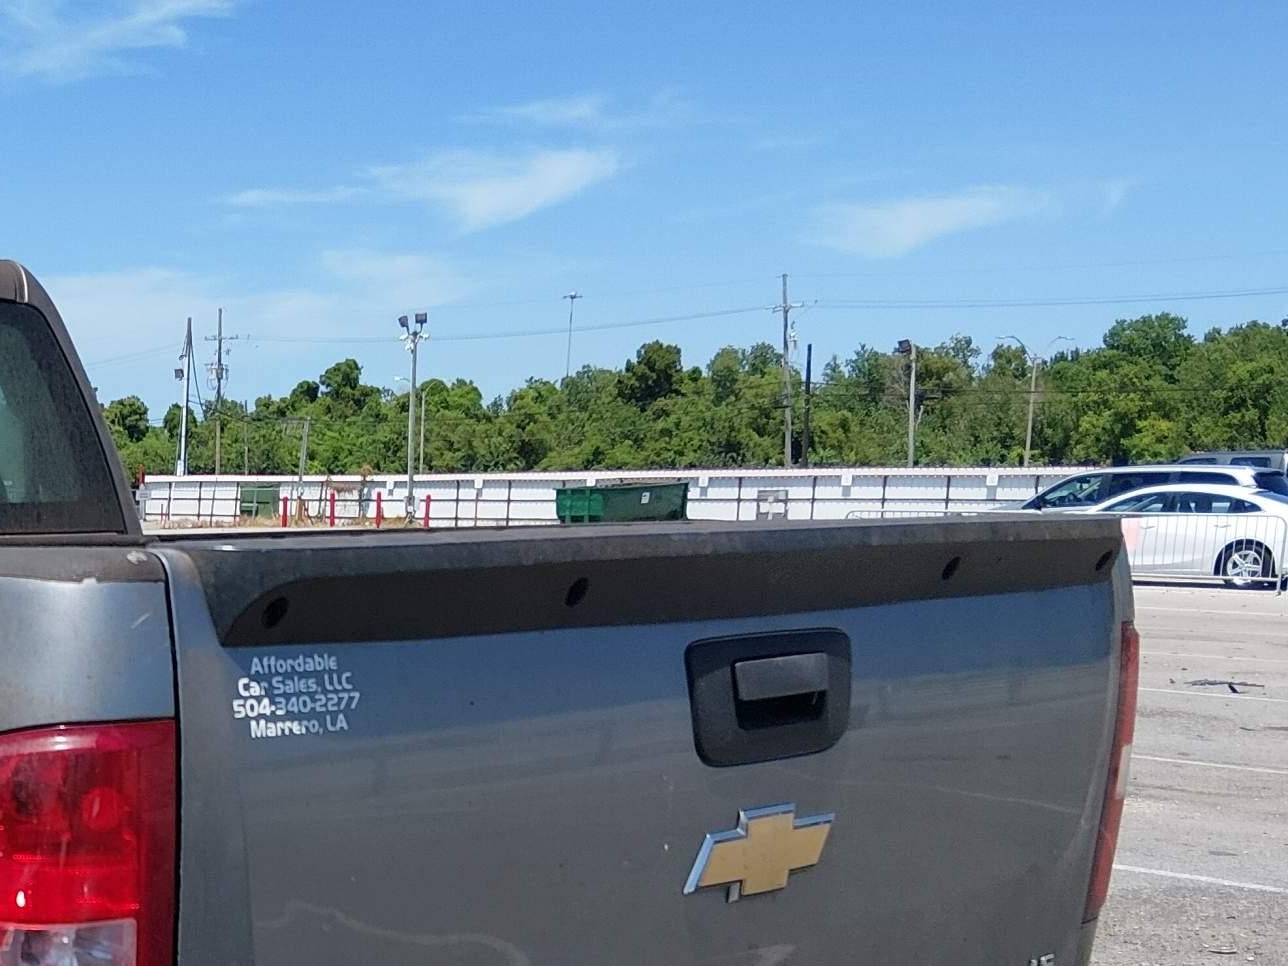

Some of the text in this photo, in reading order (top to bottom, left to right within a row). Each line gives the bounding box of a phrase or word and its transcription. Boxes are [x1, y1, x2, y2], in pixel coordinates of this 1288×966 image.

[250, 653, 338, 675] Affordable
[237, 672, 353, 697] Car Sales, LLC
[232, 691, 361, 719] 504-340-2277
[250, 713, 349, 739] Marrero, LA
